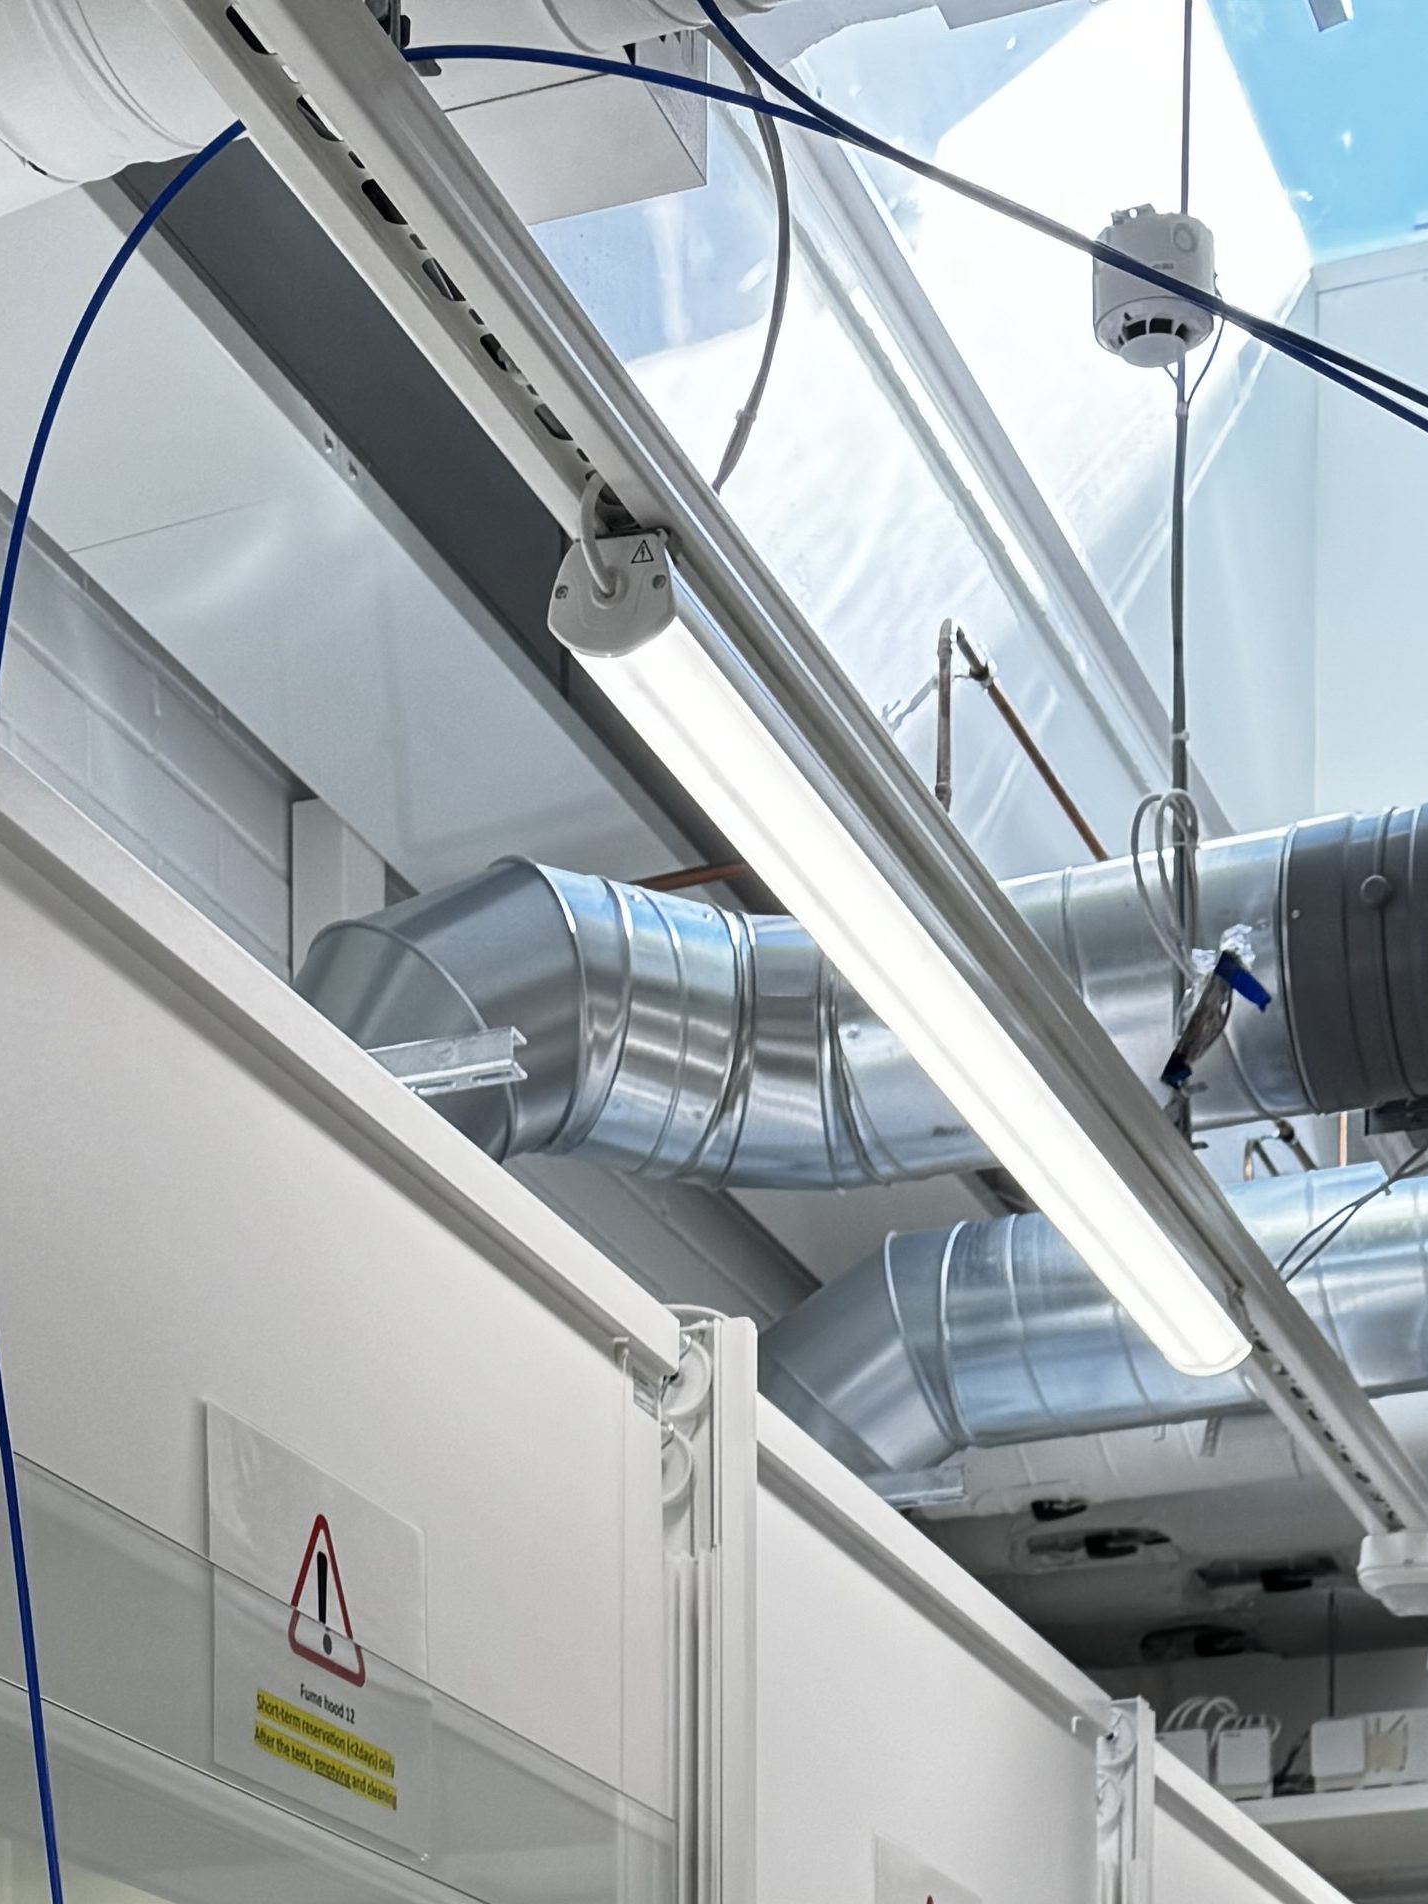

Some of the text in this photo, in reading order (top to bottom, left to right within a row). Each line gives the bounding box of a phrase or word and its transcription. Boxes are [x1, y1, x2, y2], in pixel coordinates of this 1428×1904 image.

[257, 1693, 301, 1729] Short-term
[302, 1719, 346, 1750] reservation
[300, 1683, 356, 1724] Fume hood 12
[254, 1726, 275, 1749] After
[276, 1736, 290, 1757] the
[352, 1773, 367, 1792] and
